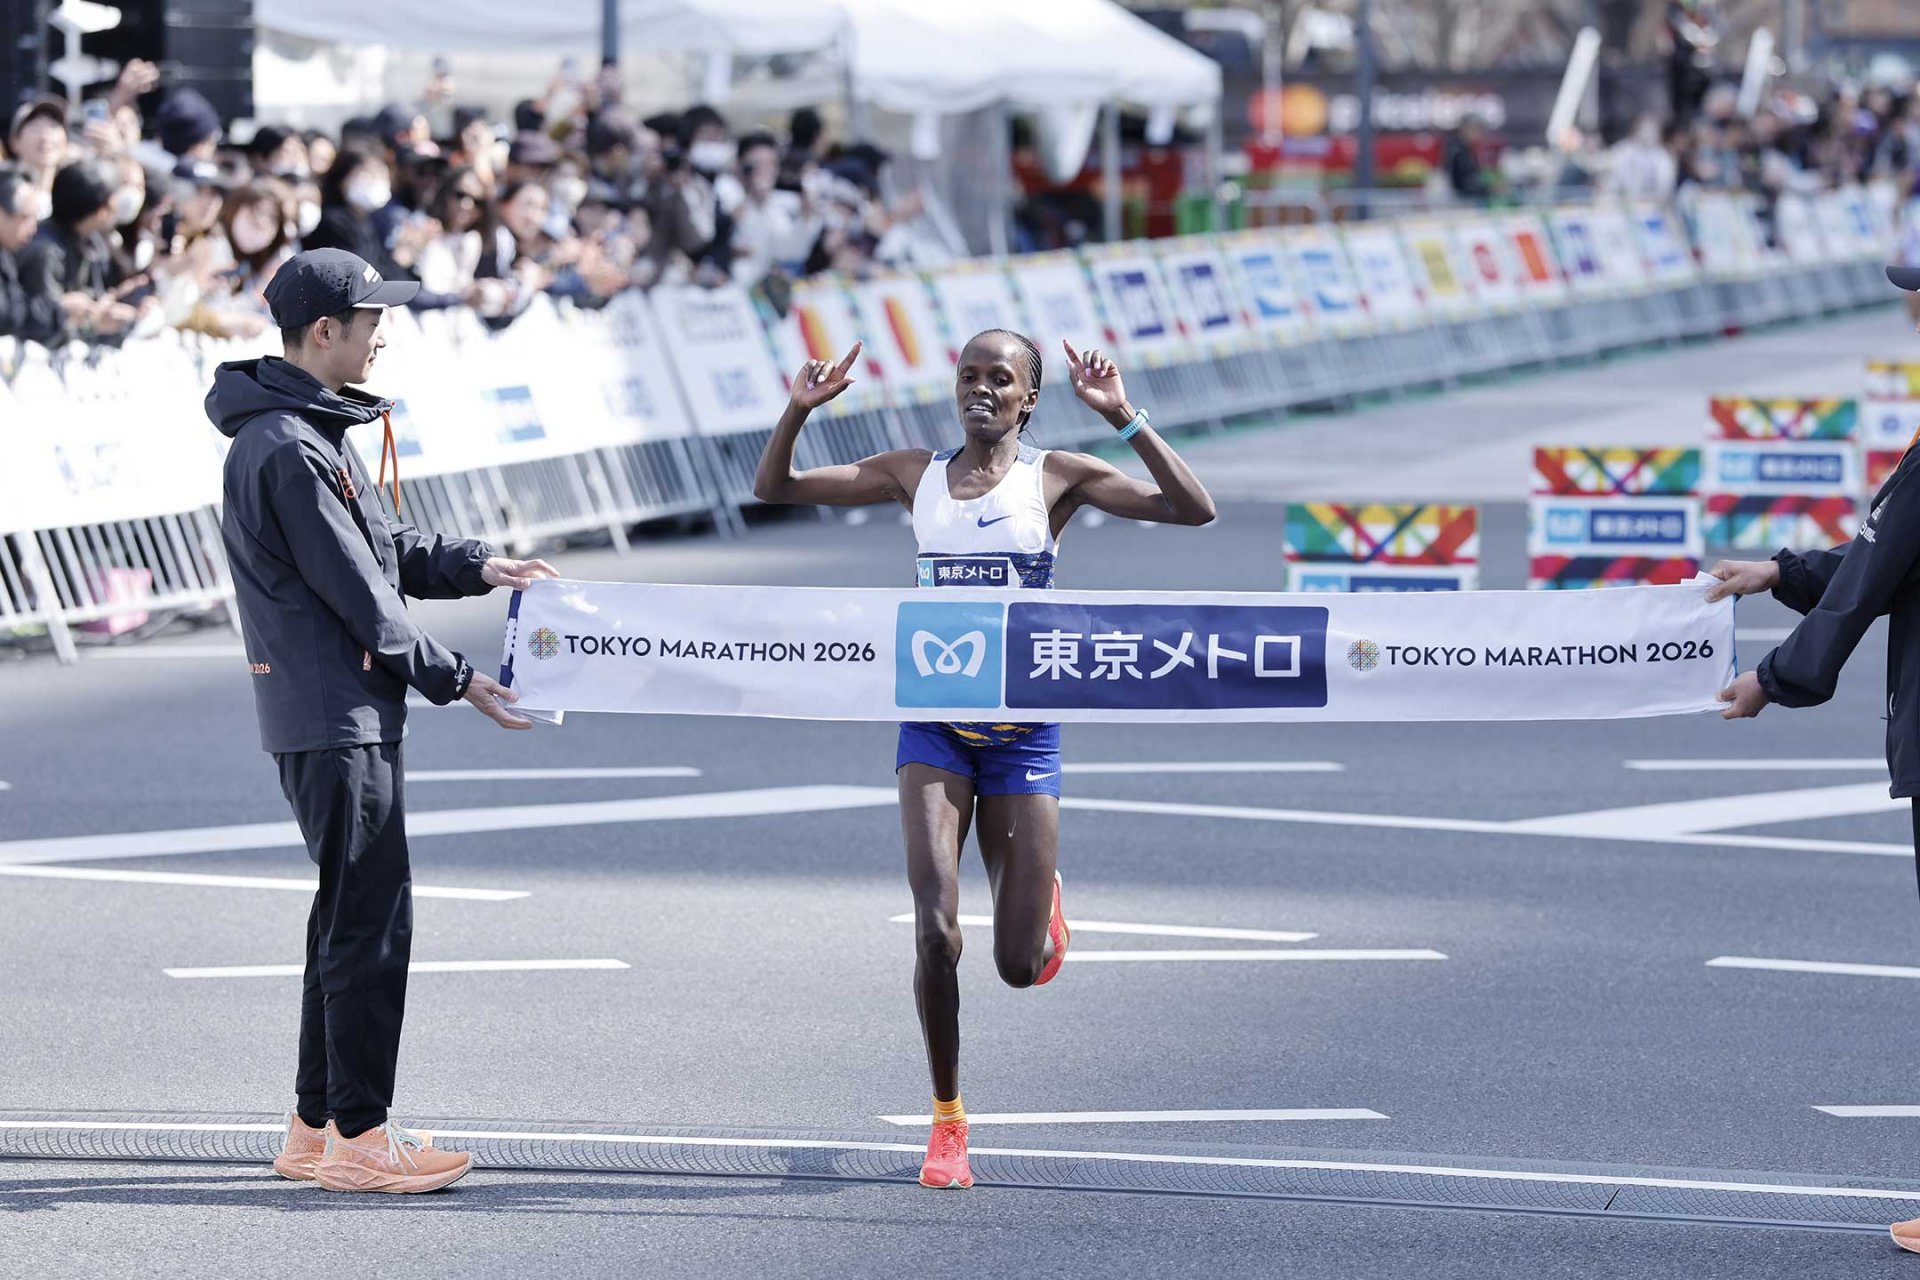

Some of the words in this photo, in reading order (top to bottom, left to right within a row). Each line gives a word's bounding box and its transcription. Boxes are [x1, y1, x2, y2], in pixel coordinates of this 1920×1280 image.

[937, 565, 1003, 580] 東京メトロ
[564, 635, 652, 657] TOKYO
[659, 638, 805, 662] MARATHON
[813, 642, 876, 662] 2026
[1029, 626, 1302, 681] 東京メトロ
[1386, 645, 1476, 667] TOKYO
[1486, 643, 1638, 667] MARATHON
[1646, 640, 1714, 663] 2026
